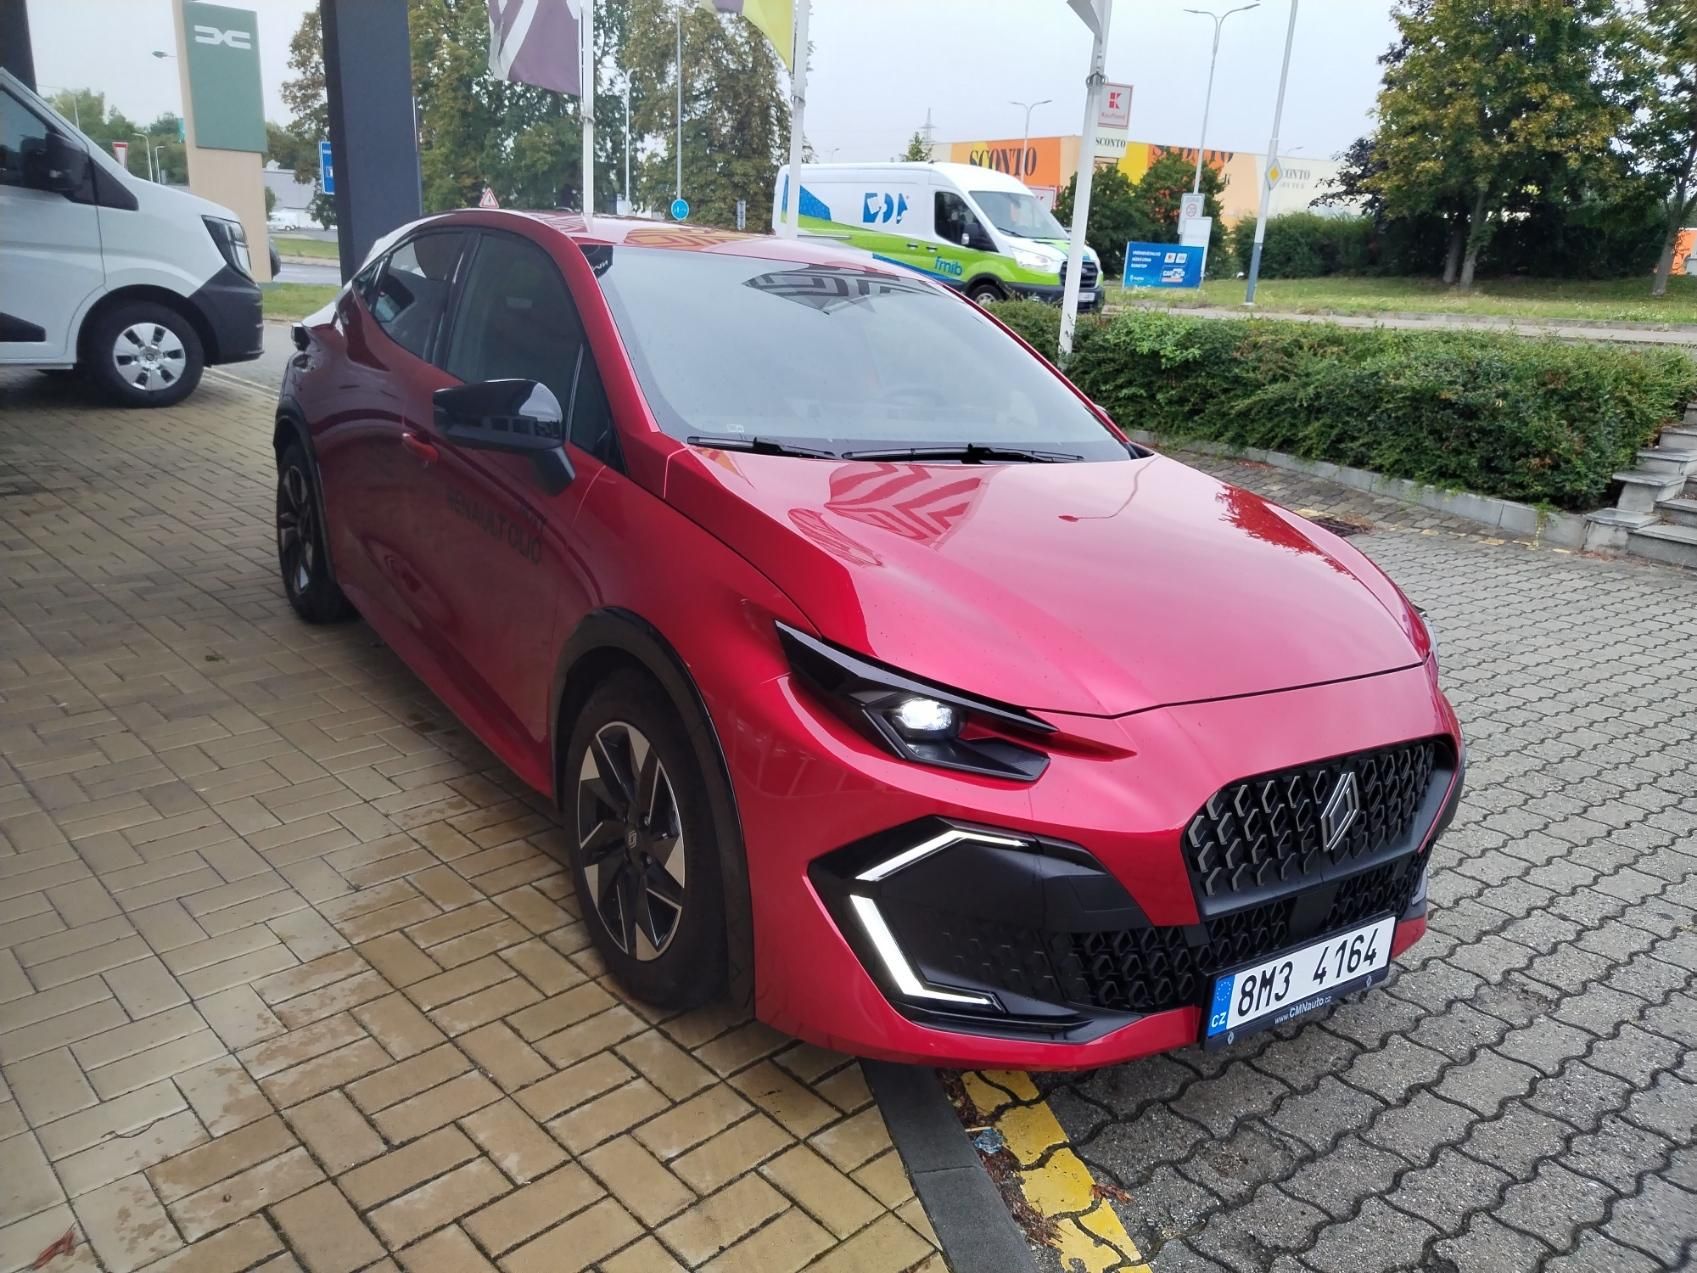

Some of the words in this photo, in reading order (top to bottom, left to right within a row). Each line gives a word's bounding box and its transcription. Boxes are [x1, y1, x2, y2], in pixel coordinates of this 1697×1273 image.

[1095, 137, 1126, 148] SCONTO
[969, 147, 1037, 177] SCONTO
[1237, 961, 1294, 1017] 8M3
[1313, 928, 1379, 984] 4164
[1211, 1011, 1226, 1028] CZ
[1274, 996, 1332, 1025] www.CMNauto.cz
